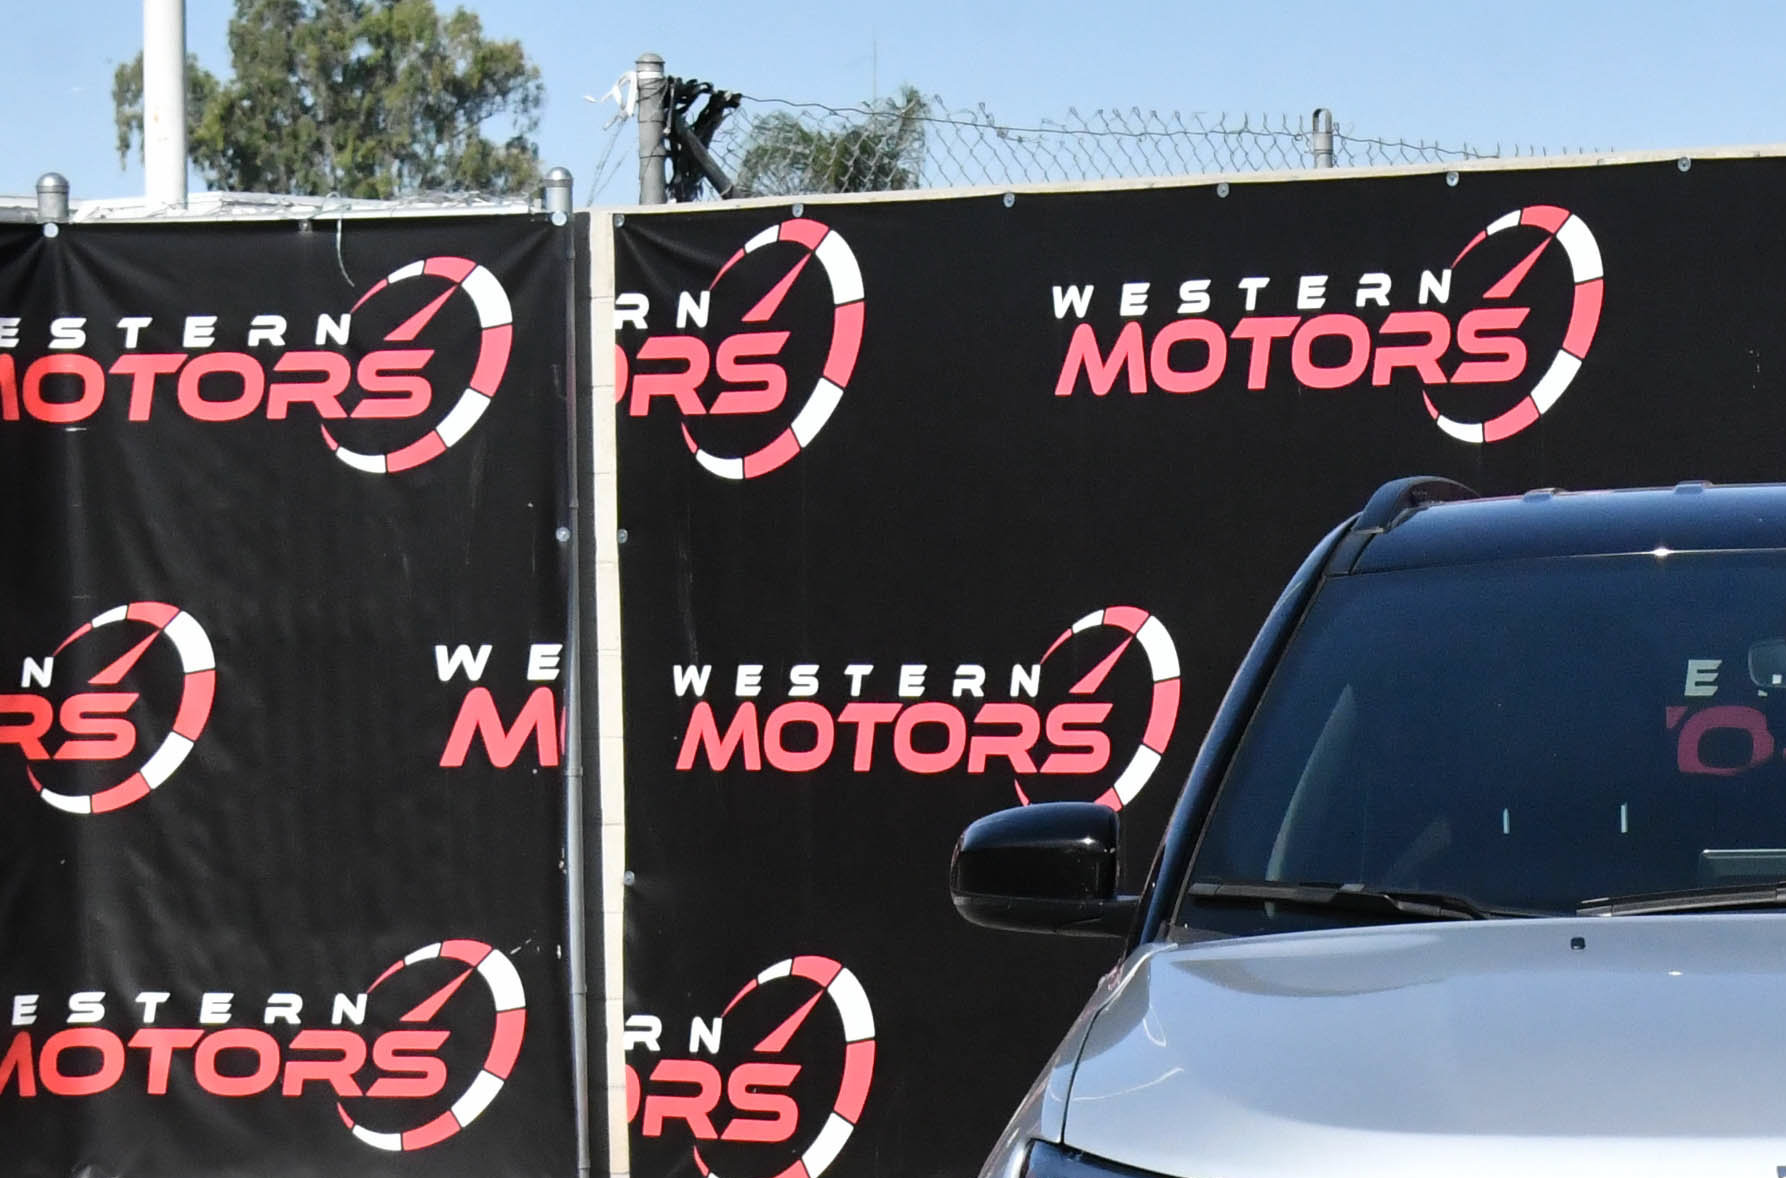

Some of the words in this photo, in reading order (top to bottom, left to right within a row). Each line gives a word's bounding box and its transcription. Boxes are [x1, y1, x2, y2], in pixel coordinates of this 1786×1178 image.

[1053, 268, 1453, 319] WESTERN
[0, 348, 435, 423] OTORS
[615, 330, 791, 416] RS
[1054, 306, 1531, 396] MOTORS
[672, 664, 1041, 698] WESTERN
[439, 685, 567, 769] M
[676, 700, 1114, 774] MOTORS
[625, 1058, 802, 1143] RS
